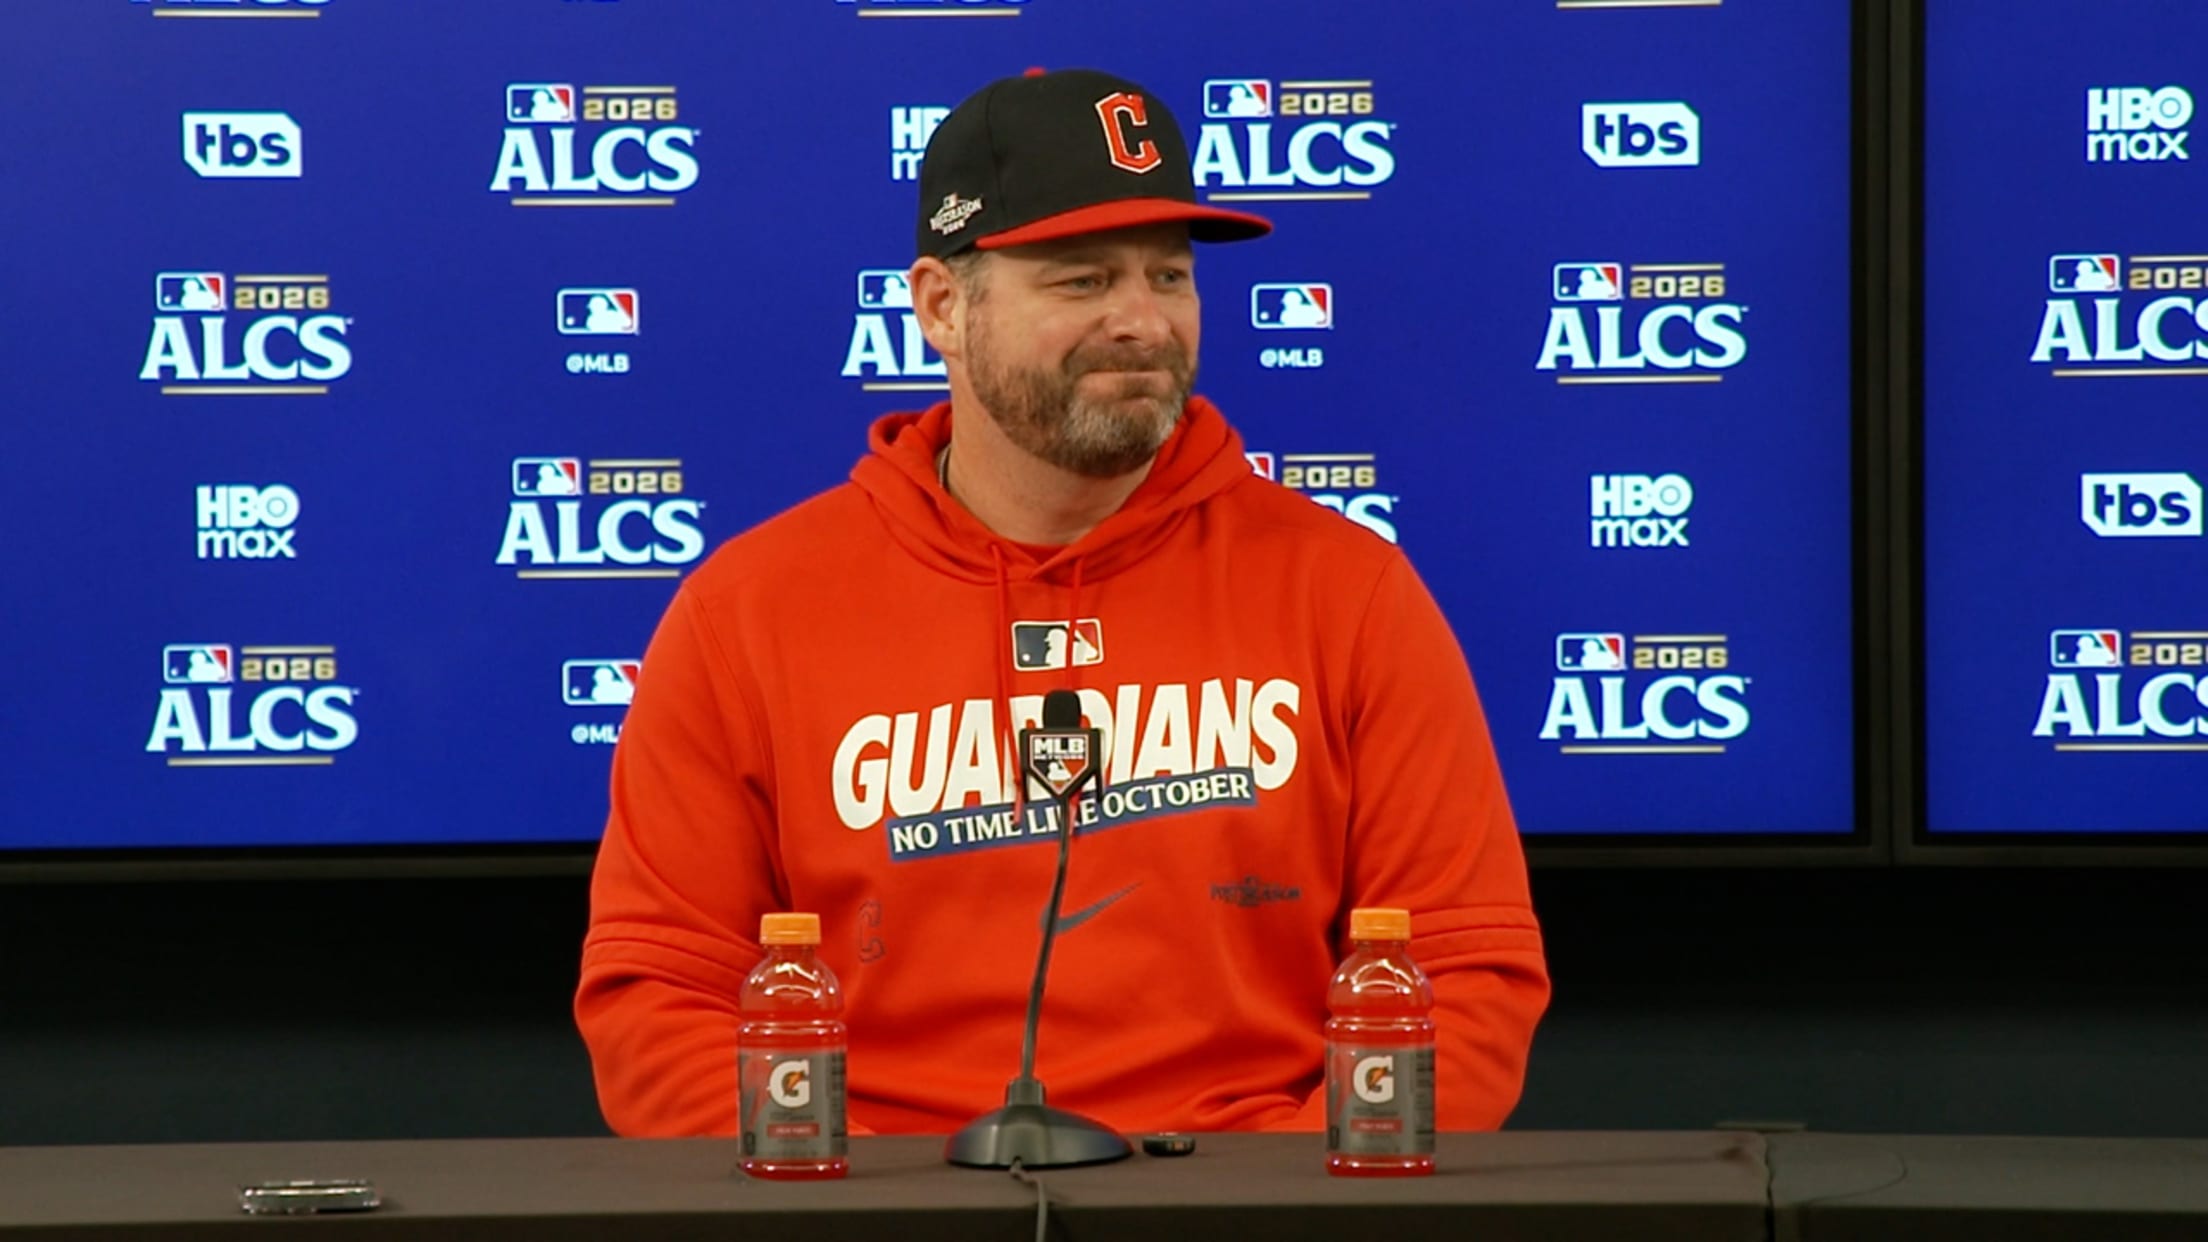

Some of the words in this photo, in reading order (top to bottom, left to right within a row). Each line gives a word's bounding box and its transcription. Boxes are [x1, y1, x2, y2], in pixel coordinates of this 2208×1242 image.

[583, 98, 677, 121] 2026
[1280, 92, 1373, 115] 2026
[2087, 86, 2193, 130] HBO
[194, 123, 291, 167] tbs
[1095, 92, 1162, 174] C
[1193, 121, 1395, 187] ALCS
[1593, 113, 1688, 156] tbs
[2087, 132, 2188, 161] max
[490, 127, 699, 192] ALCS
[234, 286, 329, 310] 2026
[1630, 275, 1725, 298] 2026
[2129, 266, 2208, 290] 202
[139, 315, 351, 381] ALCS
[841, 312, 948, 377] AL
[1535, 303, 1746, 370] ALCS
[2030, 295, 2208, 362] ALC
[566, 354, 630, 373] @MLB
[1260, 348, 1324, 368] @MLB
[589, 471, 682, 494] 2026
[1282, 466, 1375, 488] 2026
[1590, 473, 1693, 517] HBO
[196, 484, 300, 529] HBO
[2093, 482, 2191, 527] tbs
[197, 529, 296, 559] max
[496, 500, 704, 565] ALCS
[1591, 517, 1689, 547] max
[241, 658, 336, 682] 2026
[1633, 647, 1728, 669] 2026
[2130, 643, 2208, 666] 202
[146, 687, 358, 752] ALCS
[1539, 674, 1750, 740] ALCS
[2032, 672, 2208, 737] ALC
[571, 724, 622, 744] @ML
[1034, 736, 1085, 755] MLB
[891, 821, 939, 854] NO
[944, 810, 1023, 845] TIME
[1027, 798, 1099, 836] LIE
[1102, 772, 1252, 819] OCTOBER
[769, 1059, 810, 1108] G
[1353, 1055, 1394, 1104] G
